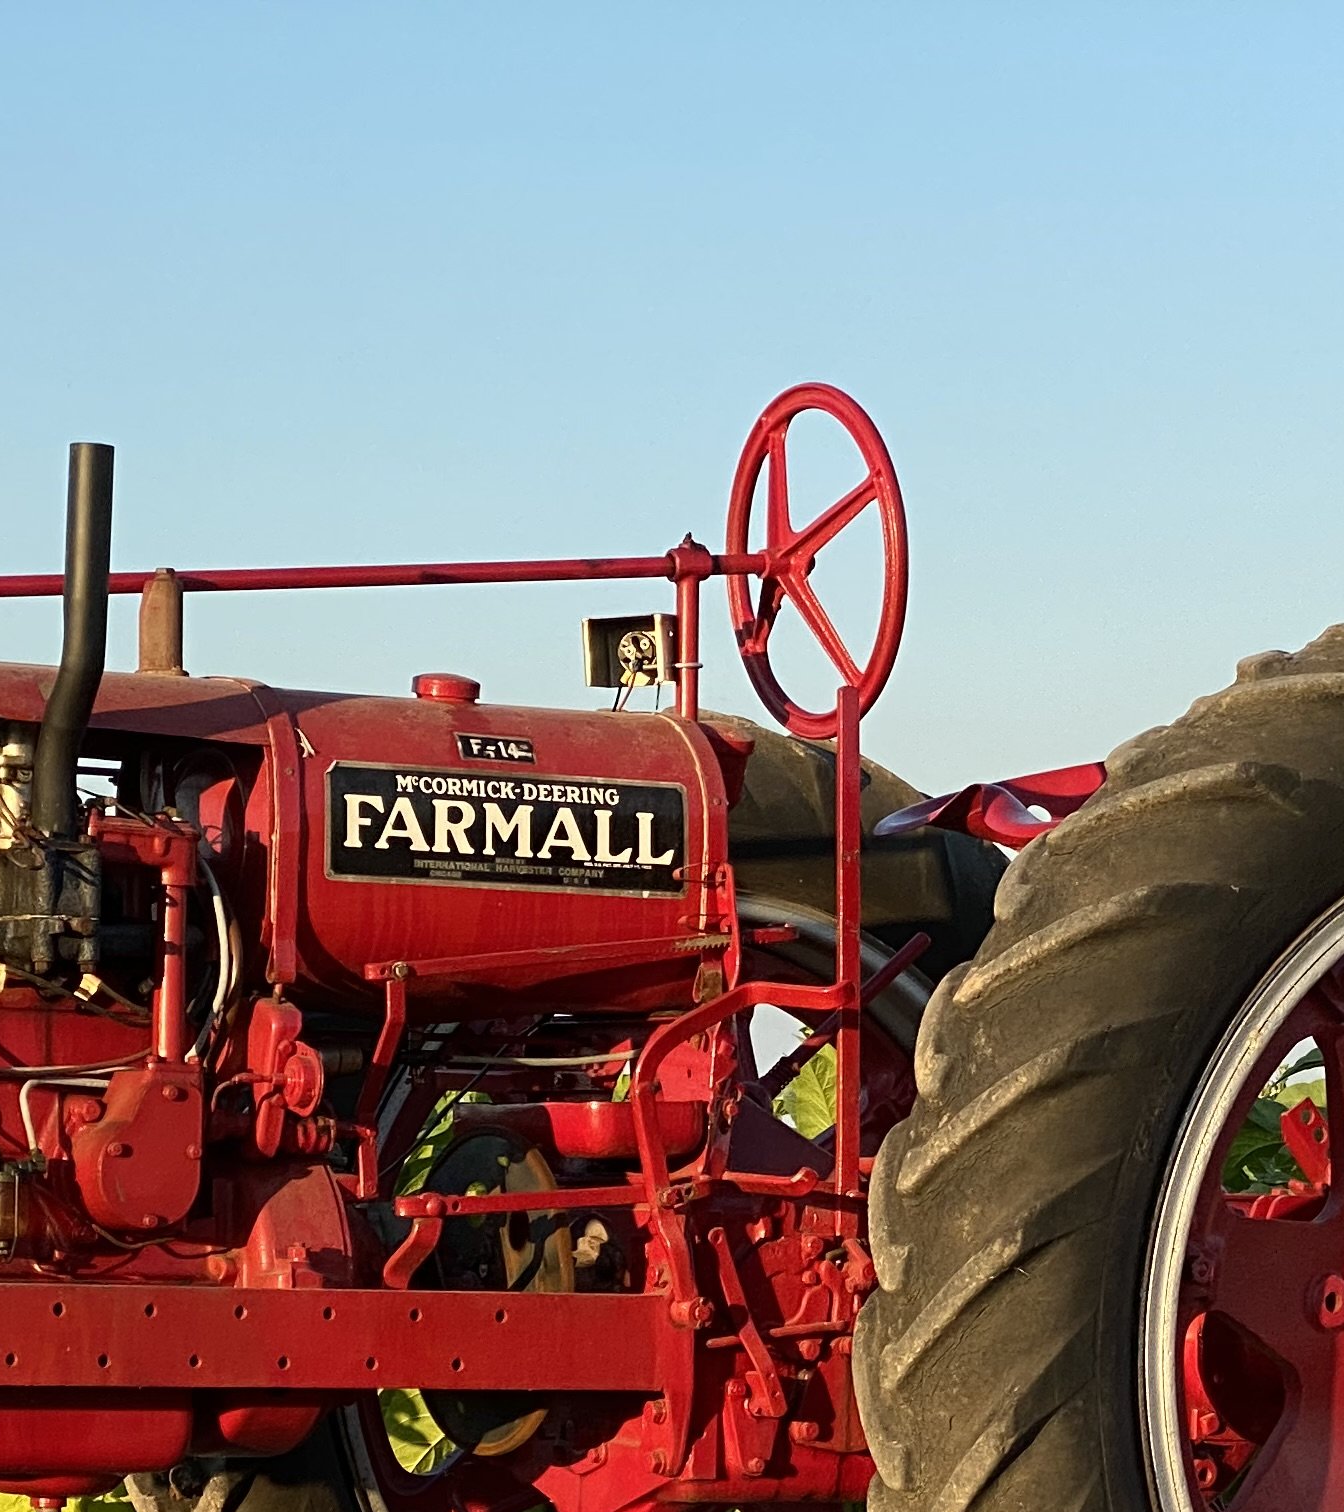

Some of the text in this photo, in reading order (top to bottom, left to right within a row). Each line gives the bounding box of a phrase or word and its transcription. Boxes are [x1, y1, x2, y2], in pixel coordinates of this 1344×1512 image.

[395, 774, 621, 806] McCORMICK-DEERING
[343, 793, 675, 866] FARMALL
[413, 859, 490, 872] INTERNATIONAL
[495, 863, 553, 876] HARVESTER
[558, 867, 605, 879] COMPANY
